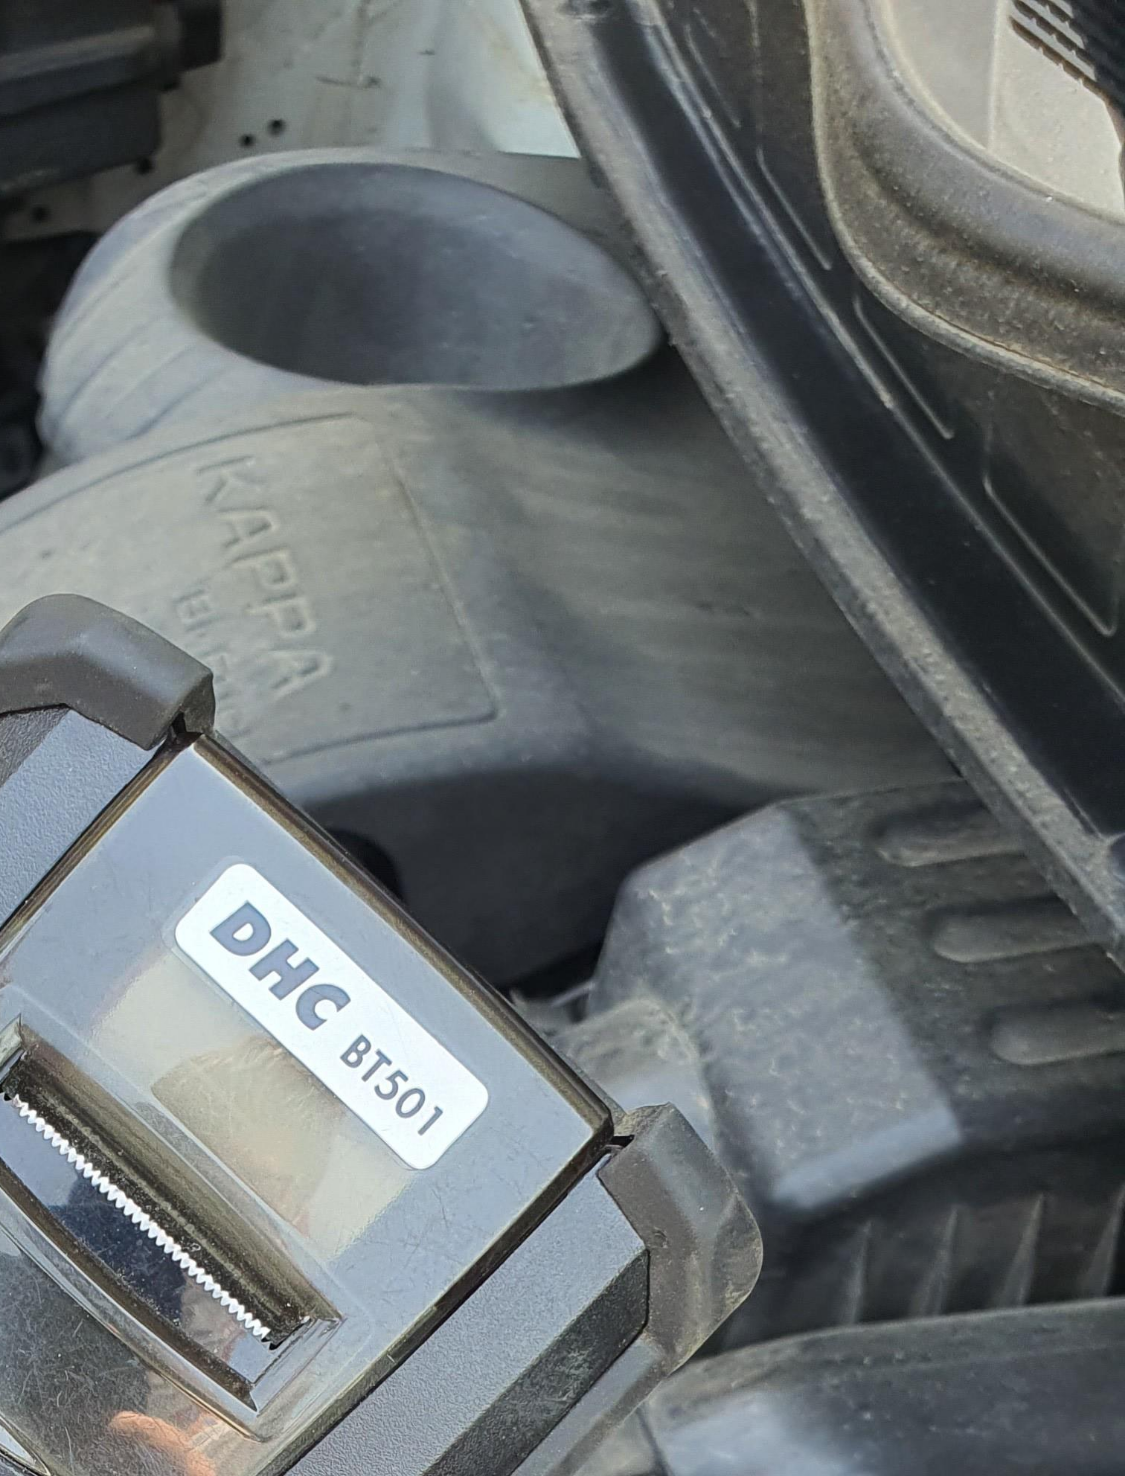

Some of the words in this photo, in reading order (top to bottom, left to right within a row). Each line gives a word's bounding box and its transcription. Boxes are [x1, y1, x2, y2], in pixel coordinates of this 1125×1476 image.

[196, 454, 332, 699] KAPPA
[210, 900, 351, 1031] DHC
[340, 1034, 444, 1136] BT501
